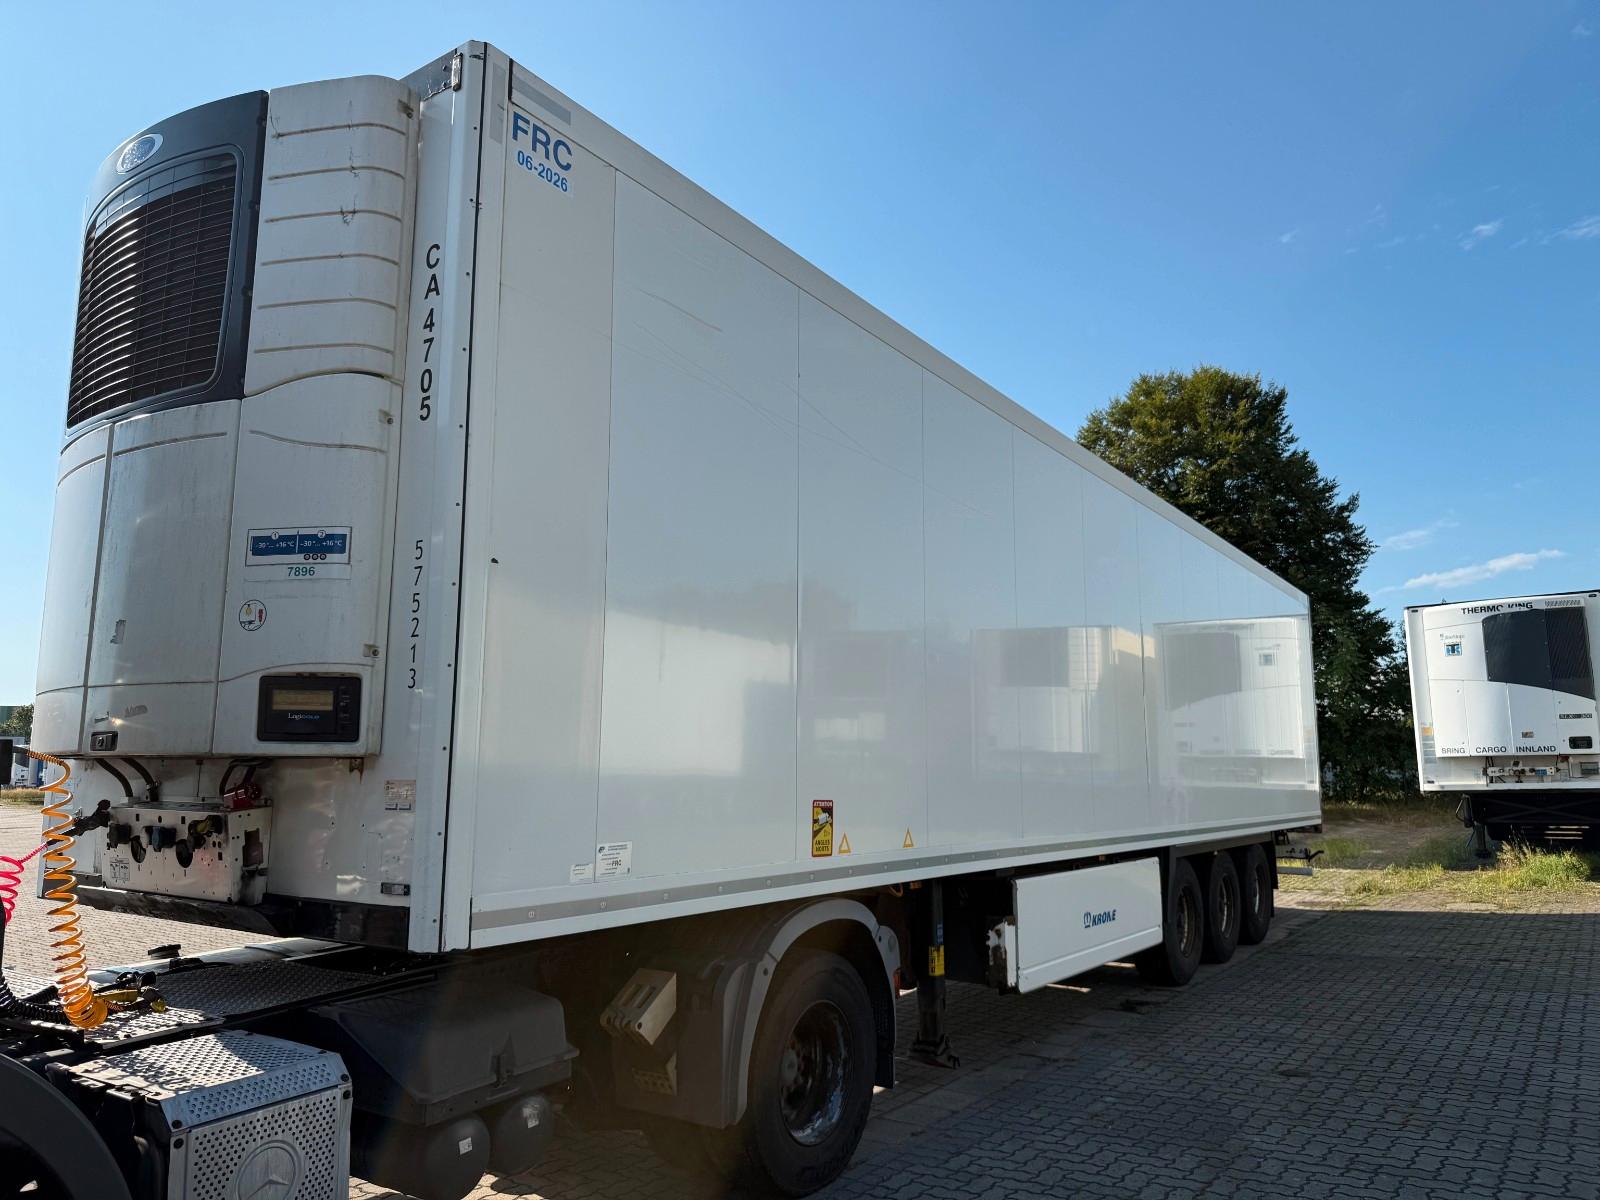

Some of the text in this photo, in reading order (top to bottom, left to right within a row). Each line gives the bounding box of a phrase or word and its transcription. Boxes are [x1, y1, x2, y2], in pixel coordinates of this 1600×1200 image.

[512, 111, 572, 171] FRC
[517, 150, 568, 192] 06-2026
[419, 243, 440, 421] CA 4705
[287, 566, 316, 576] 7896
[407, 539, 423, 689] 575213
[1461, 604, 1504, 615] THERMO
[1475, 745, 1507, 754] CARGO
[1515, 745, 1557, 753] INNLAND
[1091, 909, 1117, 927] KRONE
